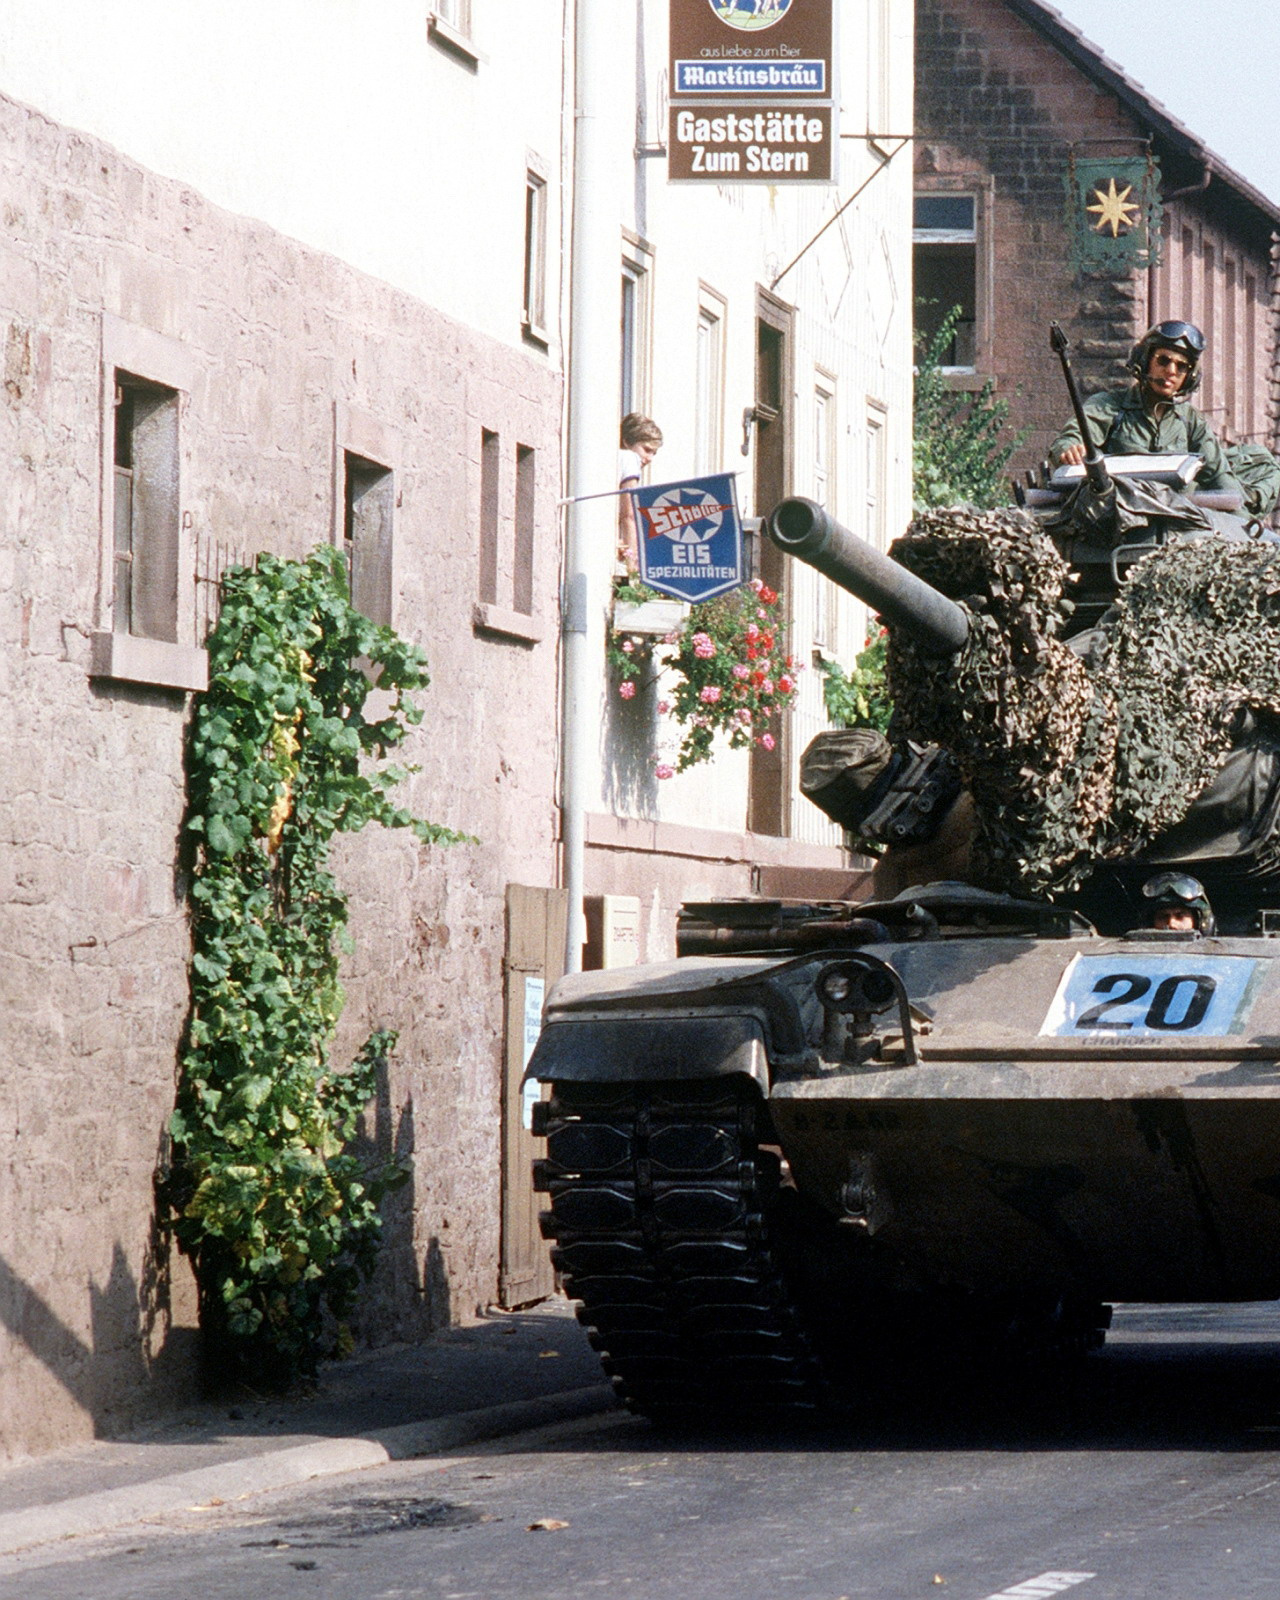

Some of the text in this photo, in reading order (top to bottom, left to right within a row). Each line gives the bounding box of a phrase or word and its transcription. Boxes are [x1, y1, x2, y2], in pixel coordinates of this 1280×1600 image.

[754, 47, 779, 57] zum
[780, 43, 801, 57] Bier
[683, 64, 818, 86] Martinsbräu
[677, 111, 823, 143] Gaststätte
[691, 145, 809, 172] Zum Stern
[647, 504, 722, 534] Schöller
[672, 544, 711, 564] EIS
[648, 565, 736, 579] SPEZIALITÄTEN
[1075, 973, 1217, 1031] 20
